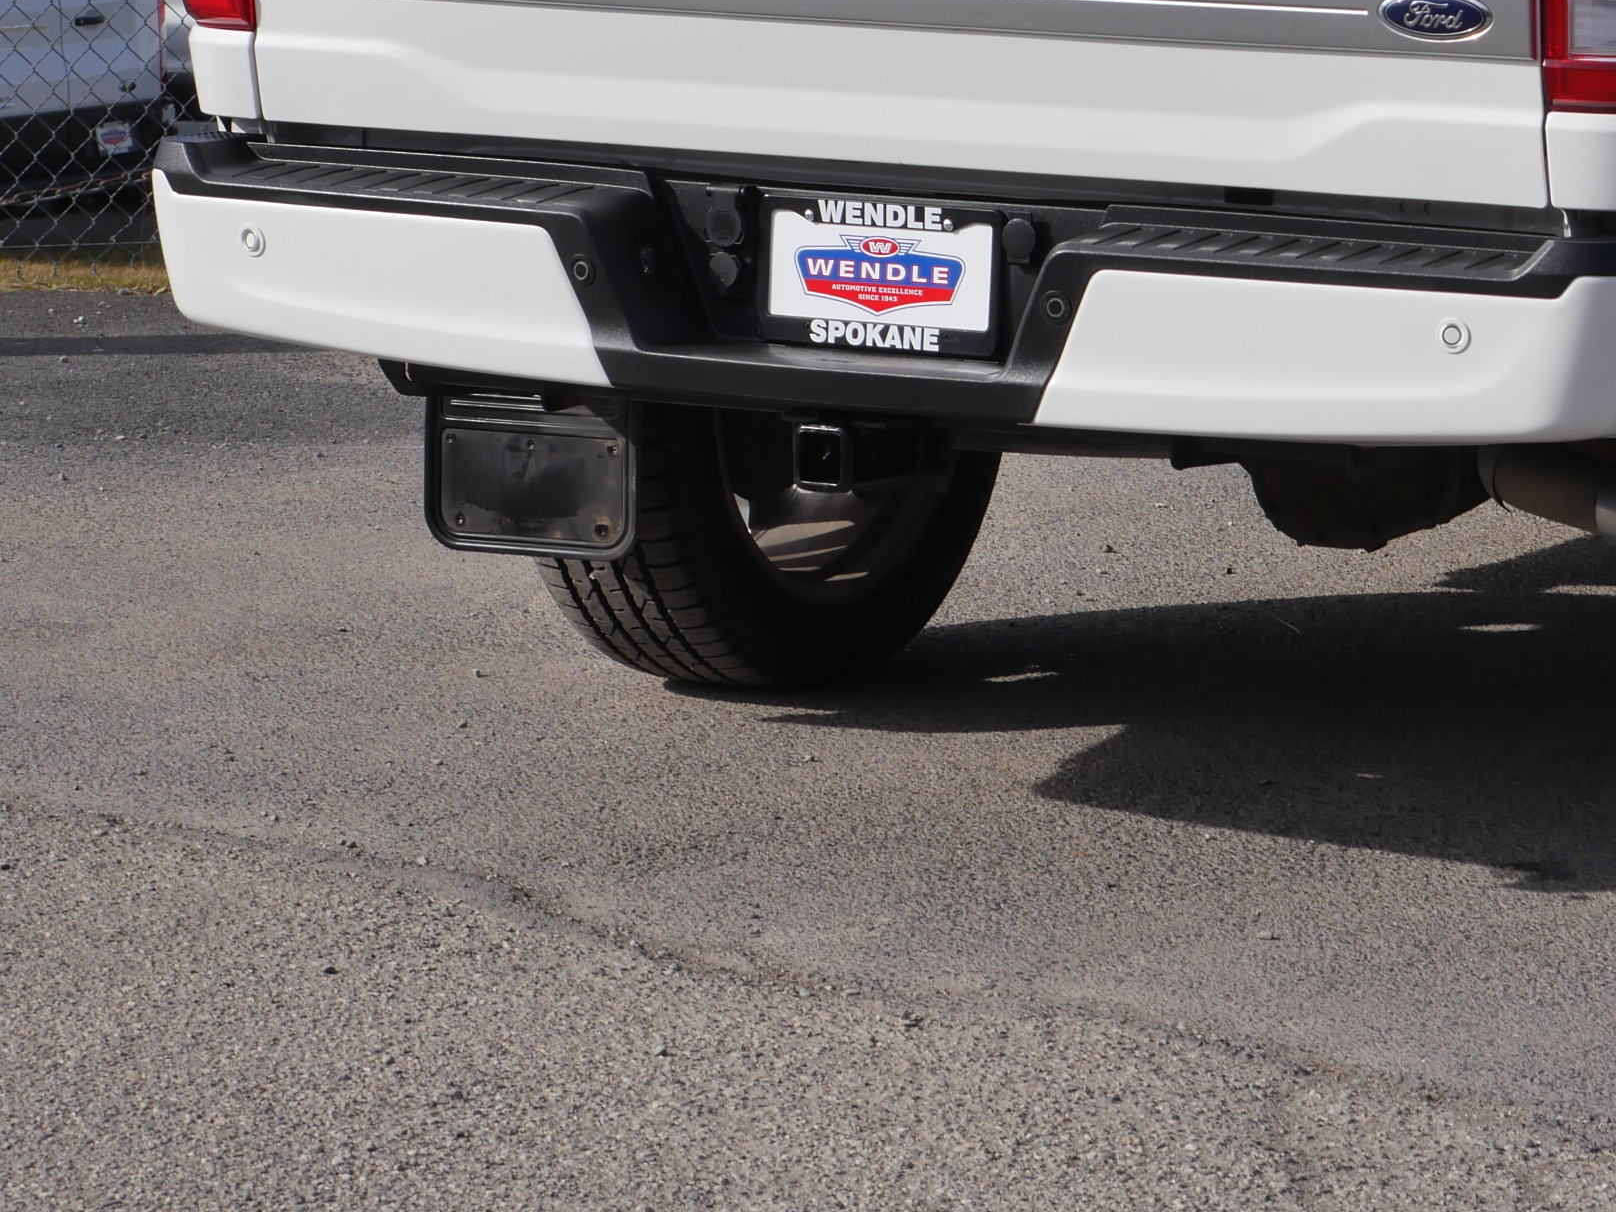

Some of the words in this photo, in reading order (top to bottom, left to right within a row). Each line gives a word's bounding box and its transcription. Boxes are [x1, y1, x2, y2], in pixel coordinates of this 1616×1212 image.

[1403, 0, 1464, 28] Ford
[817, 199, 943, 231] WENDLE
[806, 258, 949, 285] WENDLE
[831, 283, 877, 293] AUTOMOTIVE
[878, 286, 923, 296] EXCELLENCE
[858, 293, 880, 301] SINCE
[809, 318, 940, 352] SPOKANE
